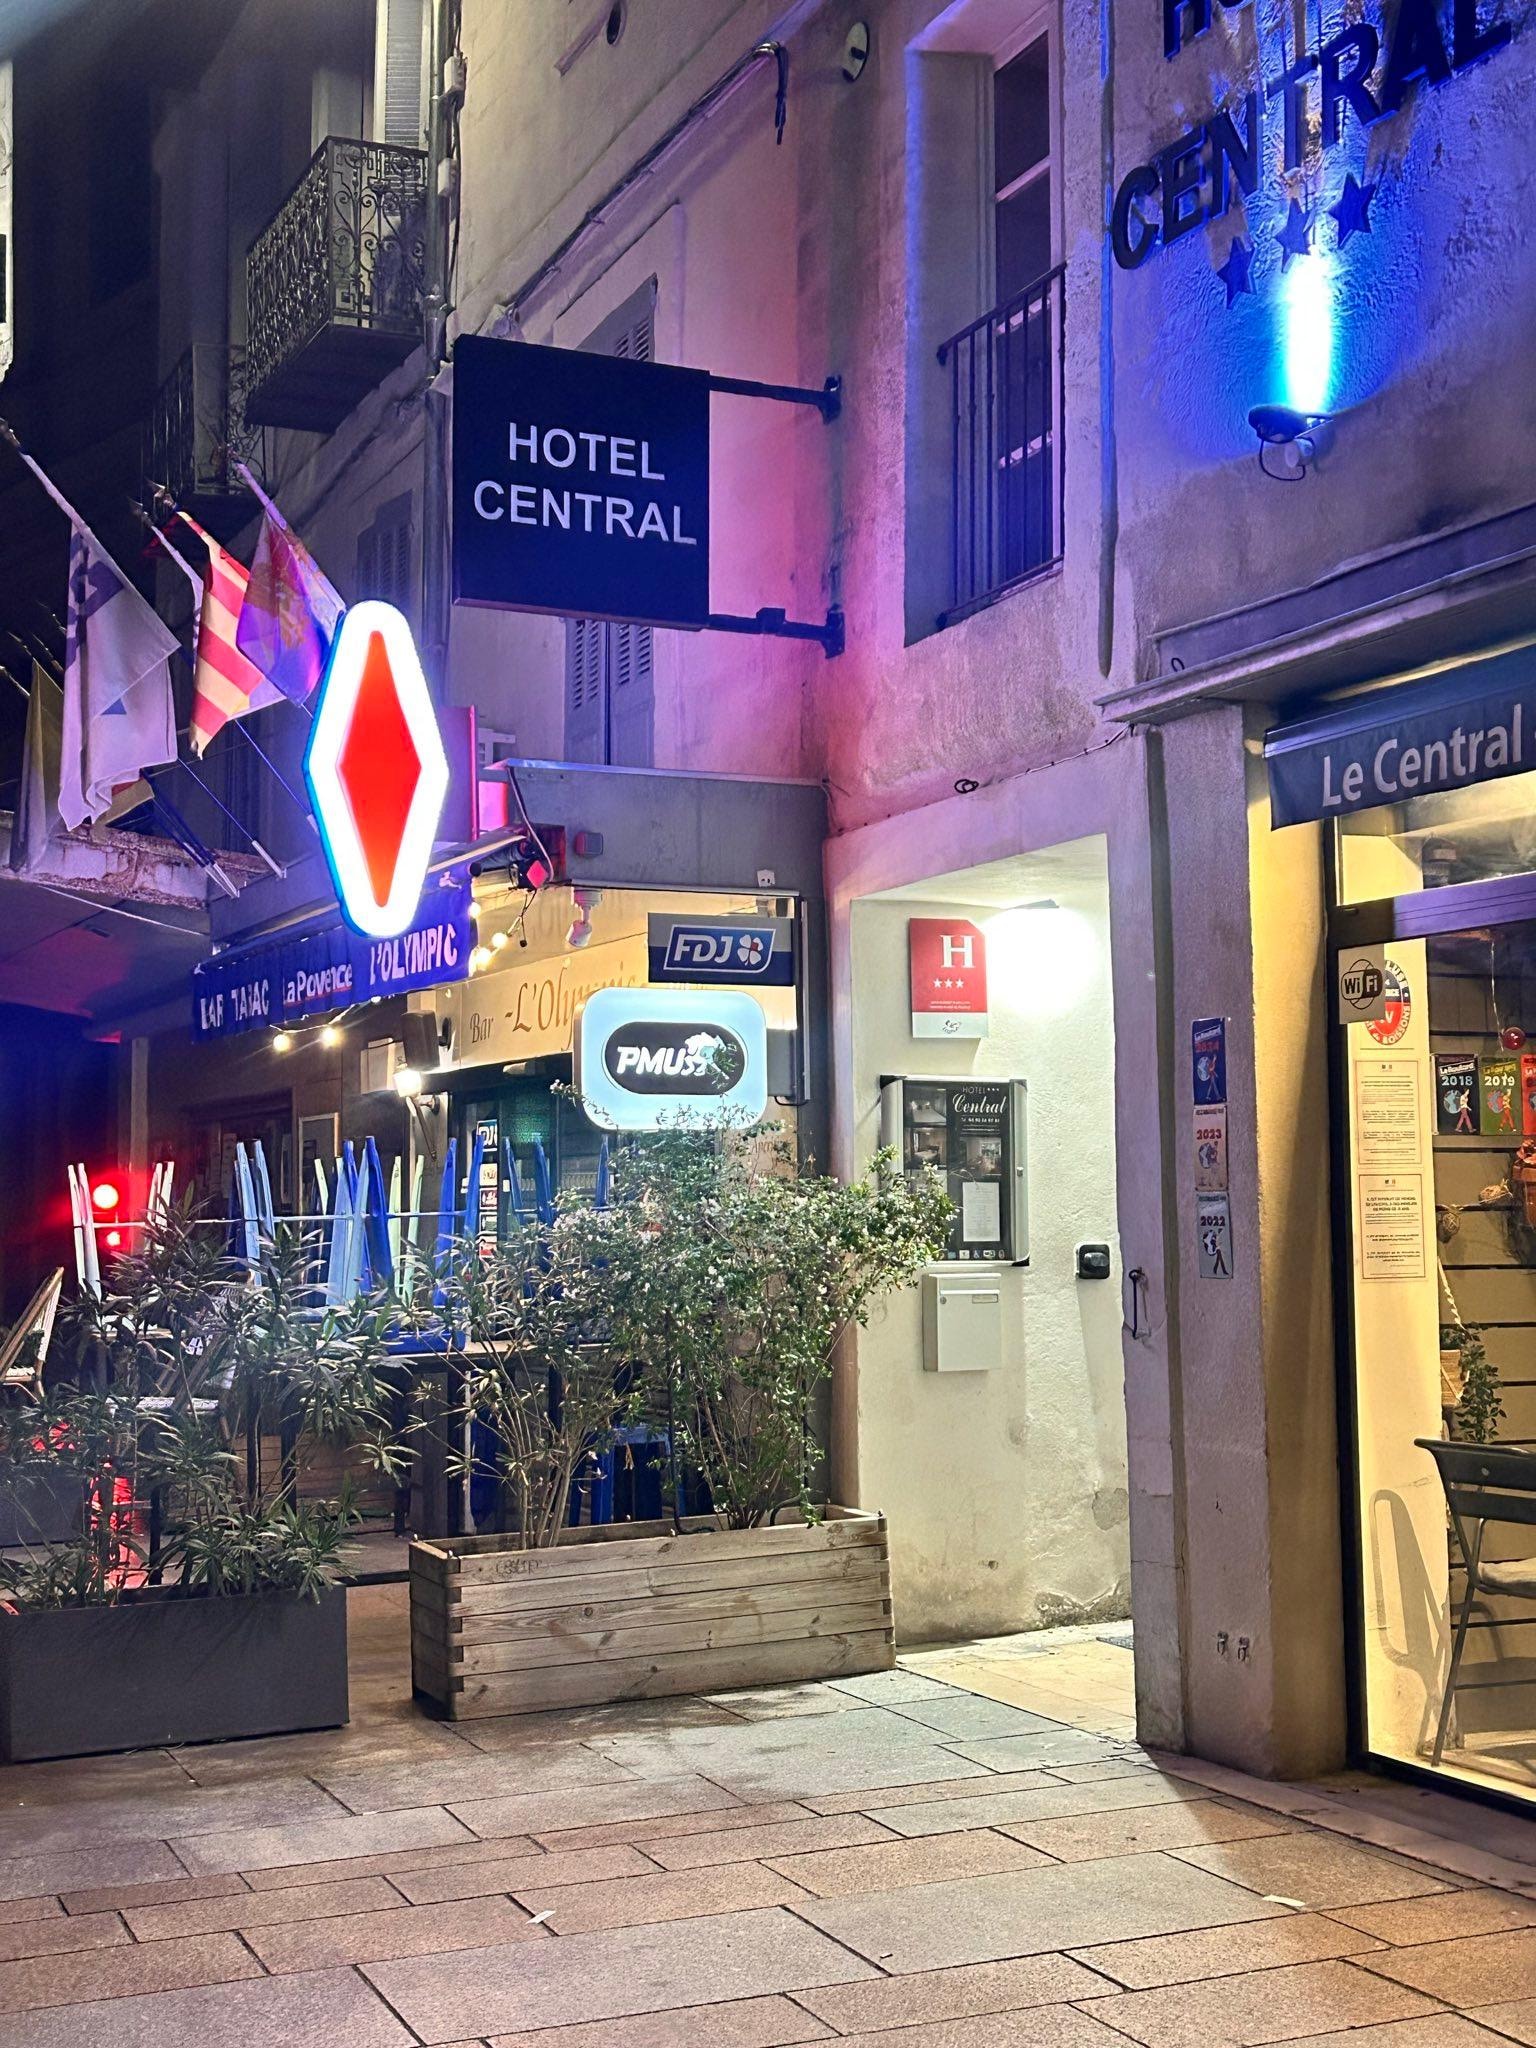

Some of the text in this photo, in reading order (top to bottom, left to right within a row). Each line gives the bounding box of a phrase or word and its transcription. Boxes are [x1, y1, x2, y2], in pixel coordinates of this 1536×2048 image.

[1112, 0, 1511, 269] CENTRAL
[509, 422, 665, 481] HOTEL
[474, 480, 697, 545] CENTRAL
[1323, 703, 1522, 807] Le Central
[370, 923, 458, 985] L'OLYMPIC
[673, 933, 733, 964] FDJ
[940, 934, 975, 968] H
[470, 1012, 494, 1043] Bar
[616, 1046, 687, 1076] PMU
[962, 1086, 986, 1094] HOTEL
[1441, 1075, 1473, 1086] 2018
[1484, 1073, 1515, 1086] 2019
[952, 1093, 1007, 1114] Central
[1196, 1129, 1222, 1140] 2023
[1200, 1216, 1226, 1227] 2022
